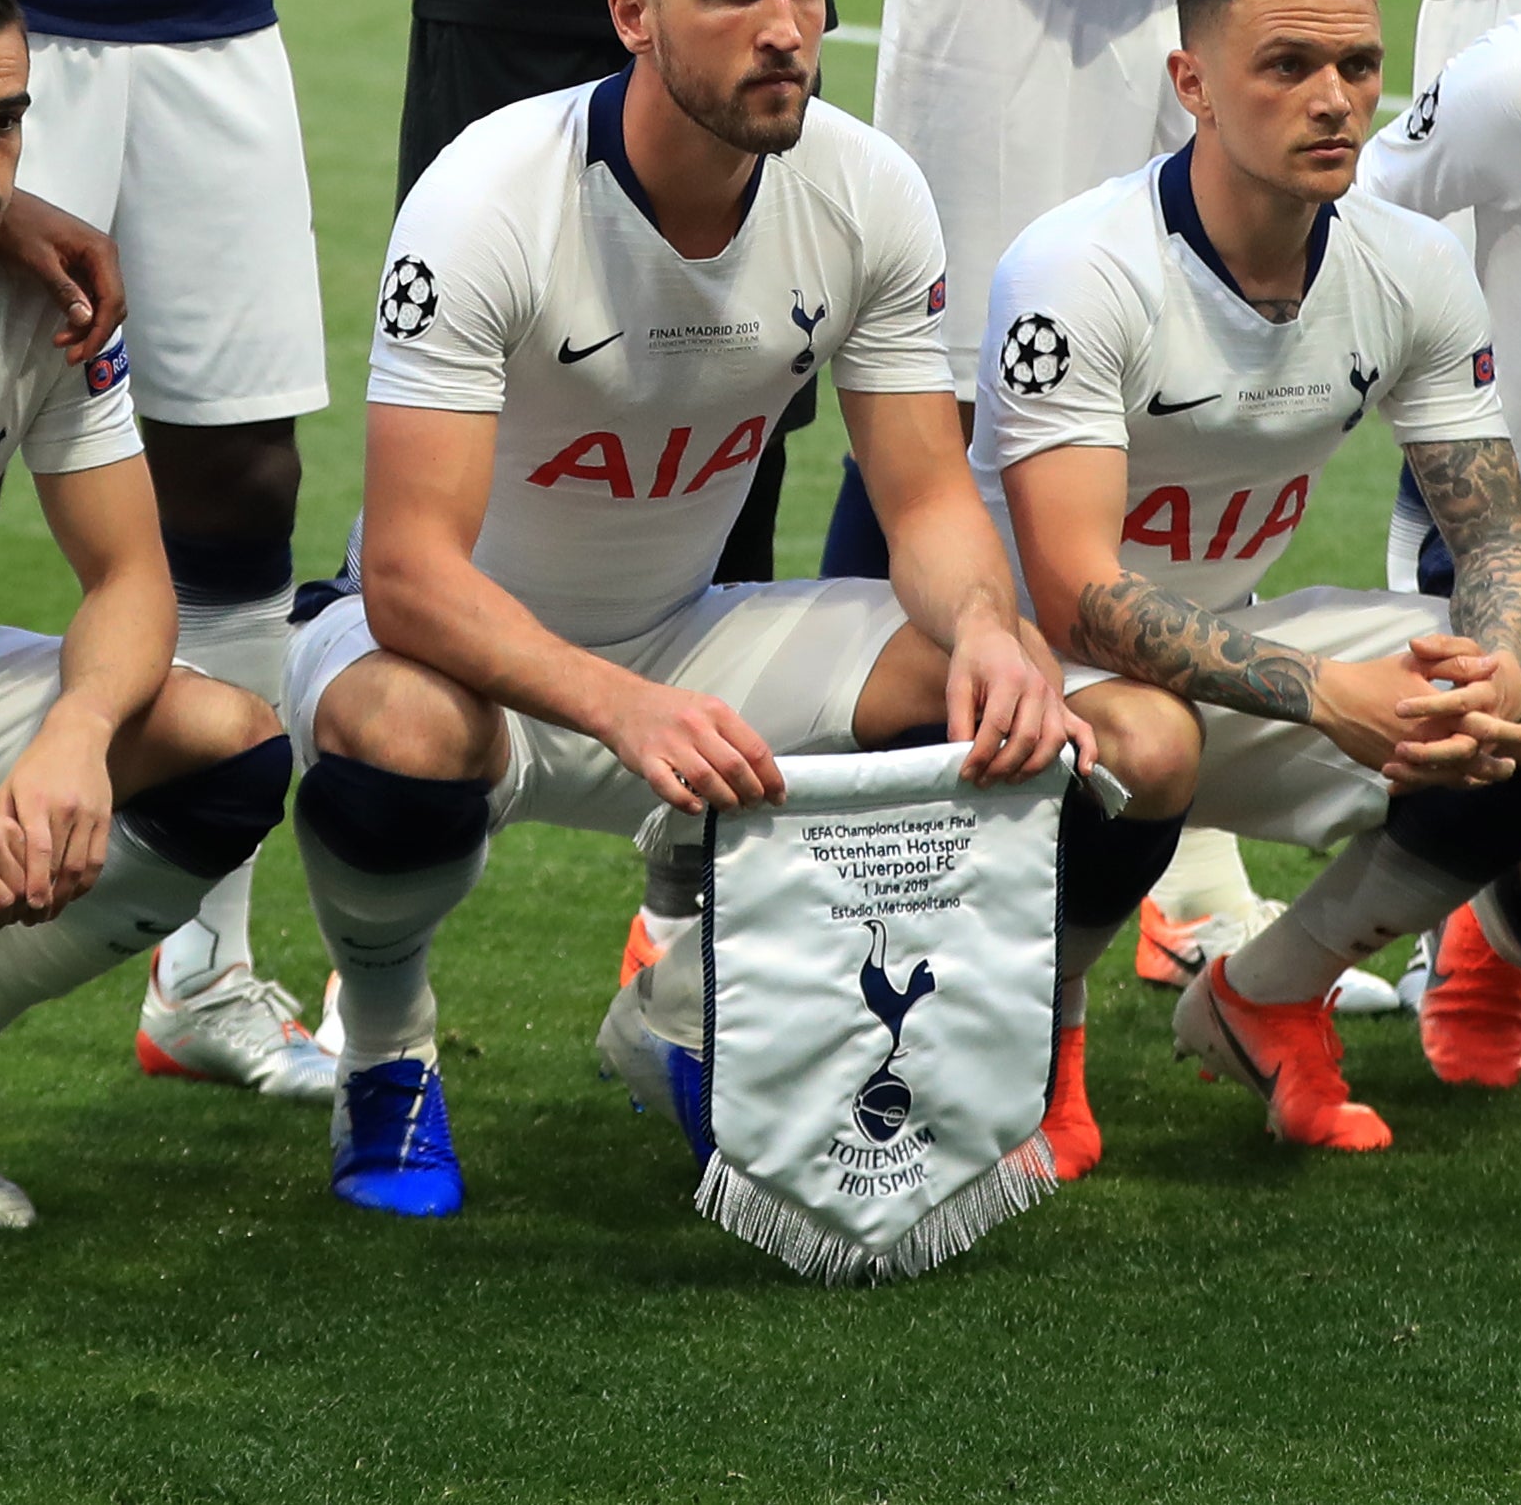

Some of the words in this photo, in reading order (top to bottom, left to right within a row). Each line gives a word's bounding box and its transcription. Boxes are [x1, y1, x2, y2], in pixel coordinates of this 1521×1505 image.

[649, 328, 683, 339] FINAL
[685, 325, 733, 336] MADRID
[735, 321, 759, 334] 2019
[1238, 390, 1265, 401] FINAL
[1267, 385, 1305, 399] MADRID
[1308, 383, 1332, 395] 2019
[525, 414, 767, 499] AIA
[1121, 474, 1309, 562] AIA
[802, 826, 833, 841] UEFA
[835, 821, 900, 840] Champions
[901, 819, 944, 836] League
[950, 814, 976, 830] Final
[810, 841, 901, 862] Tottenham
[907, 837, 971, 856] Hotspur
[837, 866, 848, 879] v
[852, 856, 930, 879] Liverpool
[936, 854, 956, 871] FC
[863, 882, 868, 896] 1
[874, 882, 900, 896] June
[904, 879, 929, 893] 2019
[831, 903, 873, 920] Estadio
[877, 896, 961, 916] Metropolitano
[827, 1126, 937, 1171] TOTTENHAM
[837, 1162, 929, 1197] HOTSPUR
